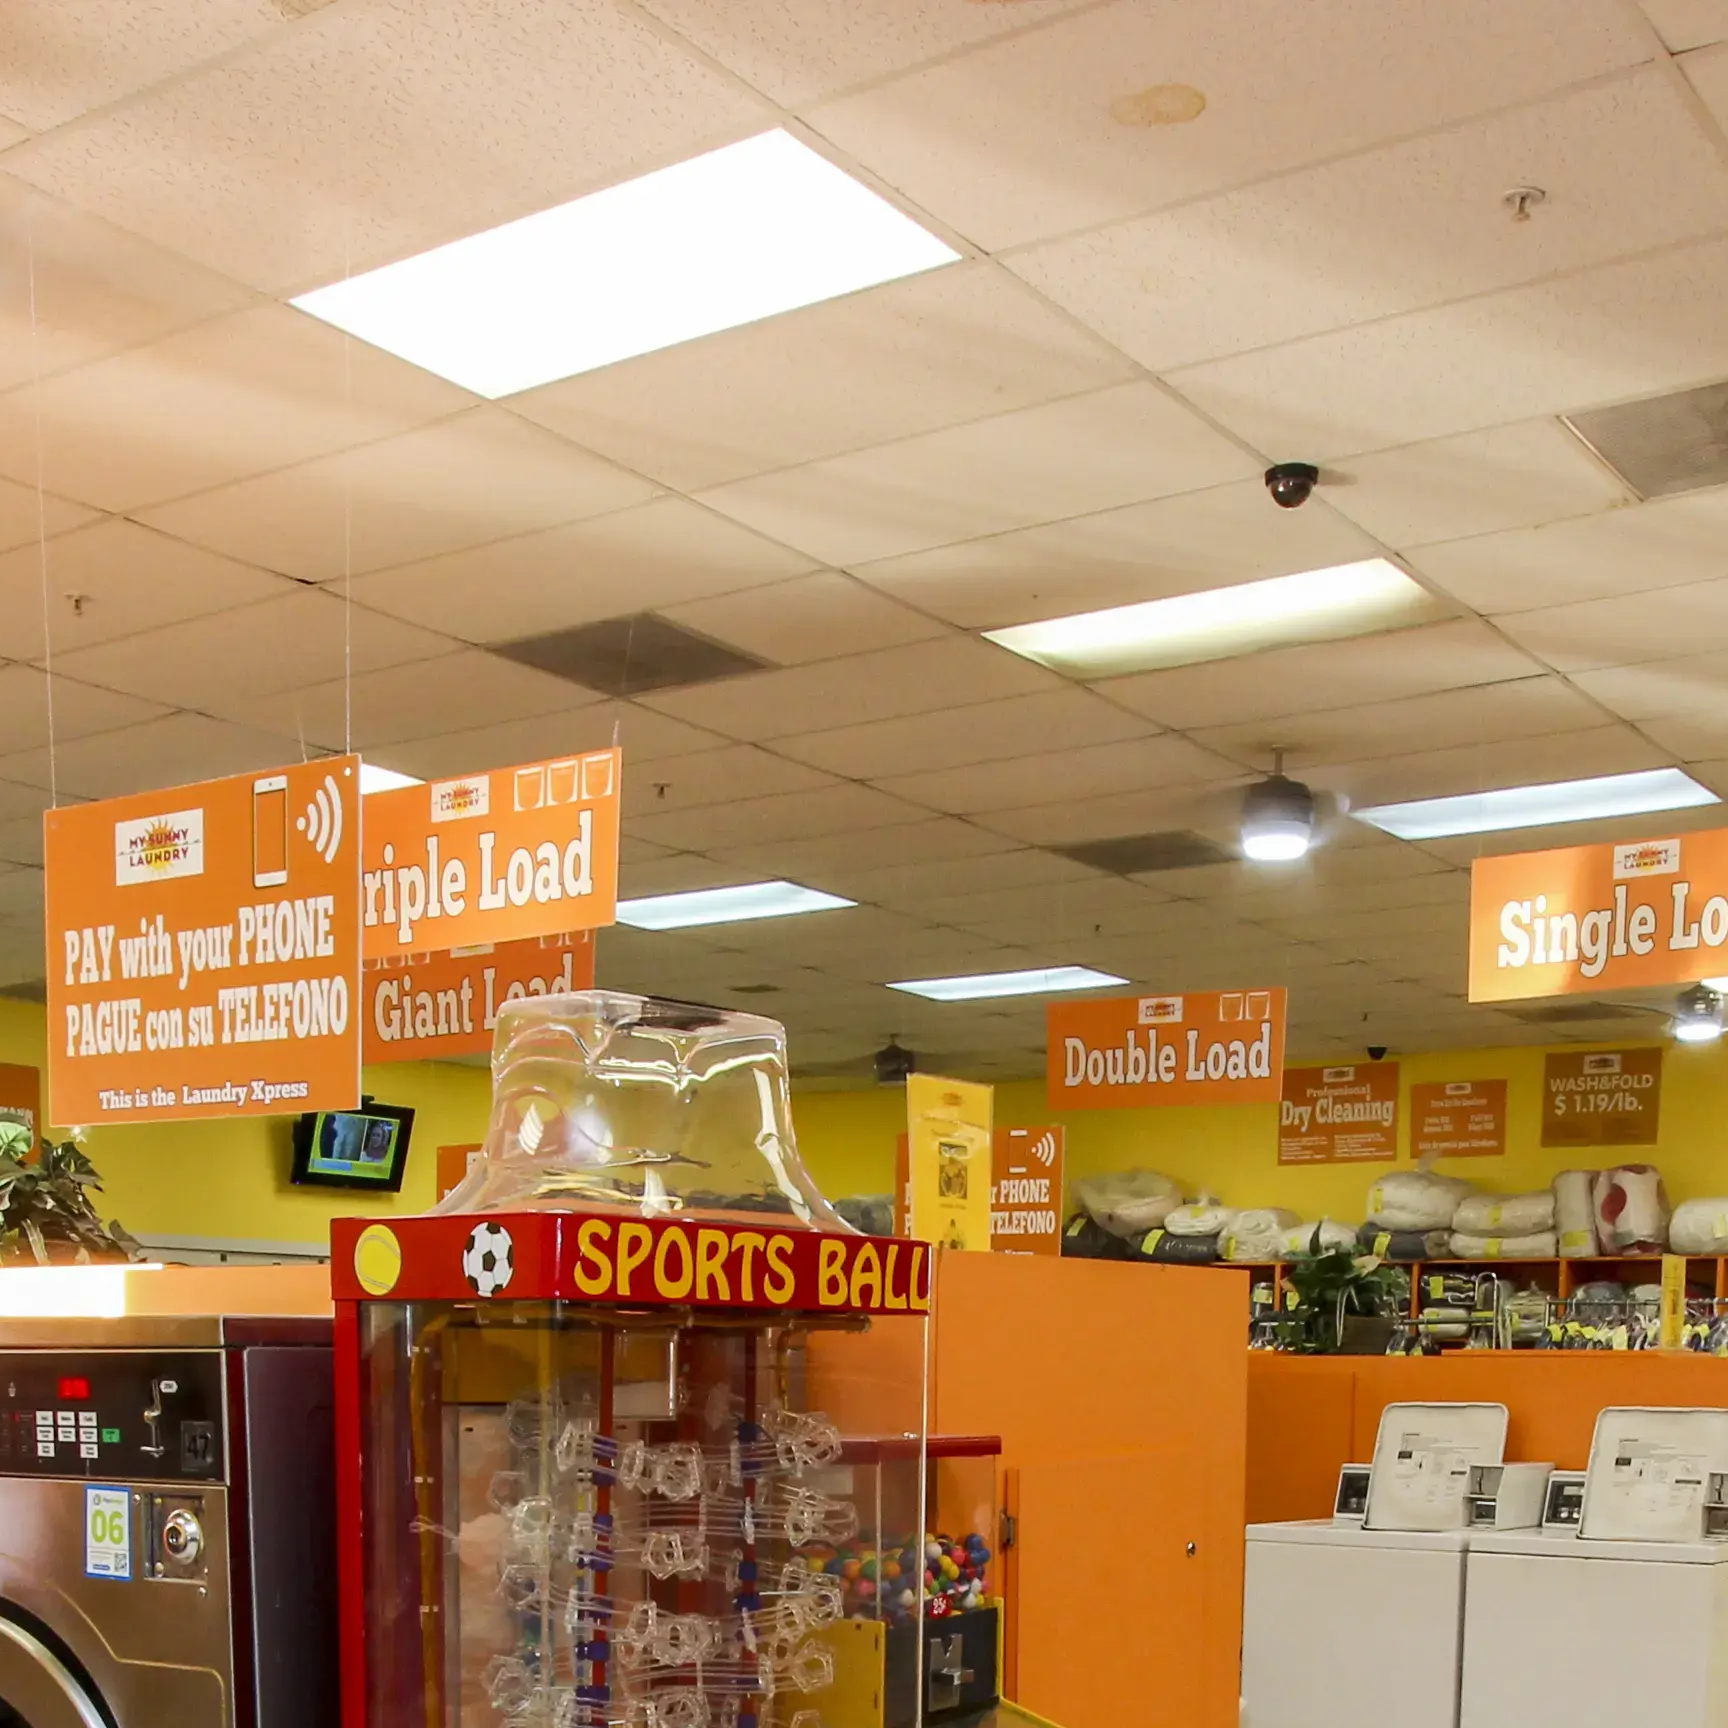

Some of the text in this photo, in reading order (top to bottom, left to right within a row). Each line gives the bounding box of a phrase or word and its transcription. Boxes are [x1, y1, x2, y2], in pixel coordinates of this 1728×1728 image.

[129, 828, 189, 850] MY SUNNY
[129, 847, 189, 868] LAUNDRY
[363, 808, 593, 944] riple Load
[1623, 857, 1669, 870] LAUNDRY
[64, 895, 334, 990] PAY with your PHONE
[1497, 884, 1657, 978] Single
[65, 975, 348, 1058] PAGUE con su TELEFONO
[374, 973, 473, 1042] Giant
[1064, 1021, 1271, 1087] Double Load
[99, 1079, 308, 1111] This is the Laundry Xpress
[1550, 1074, 1654, 1092] WASH&FOLD
[1281, 1100, 1312, 1133] Dry
[1315, 1092, 1395, 1127] Cleaning
[1554, 1093, 1567, 1116] $
[1000, 1178, 1050, 1204] PHONE
[573, 1218, 931, 1311] SPORTS BALL
[91, 1508, 124, 1545] 06
